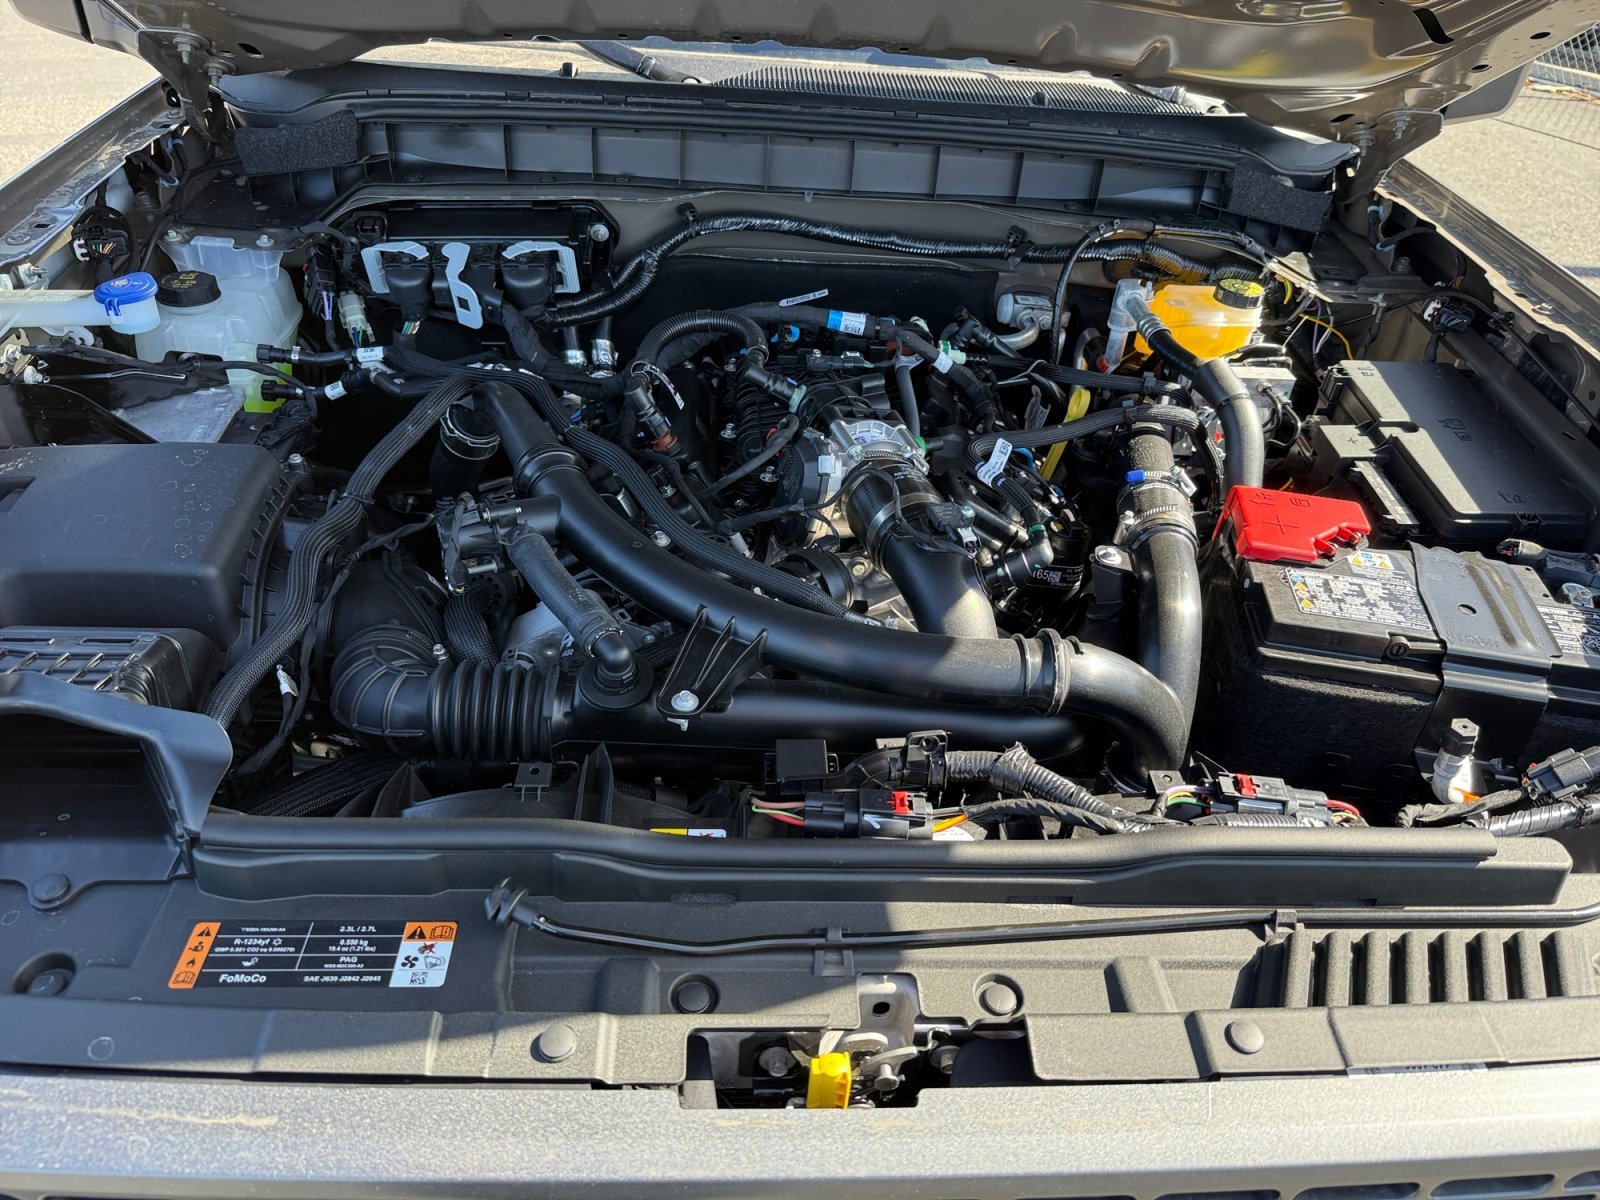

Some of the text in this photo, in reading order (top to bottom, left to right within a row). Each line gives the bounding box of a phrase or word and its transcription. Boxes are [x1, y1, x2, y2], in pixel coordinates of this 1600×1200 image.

[234, 938, 271, 946] R-1234yf
[359, 939, 369, 947] kg
[219, 973, 267, 983] FoMoCo
